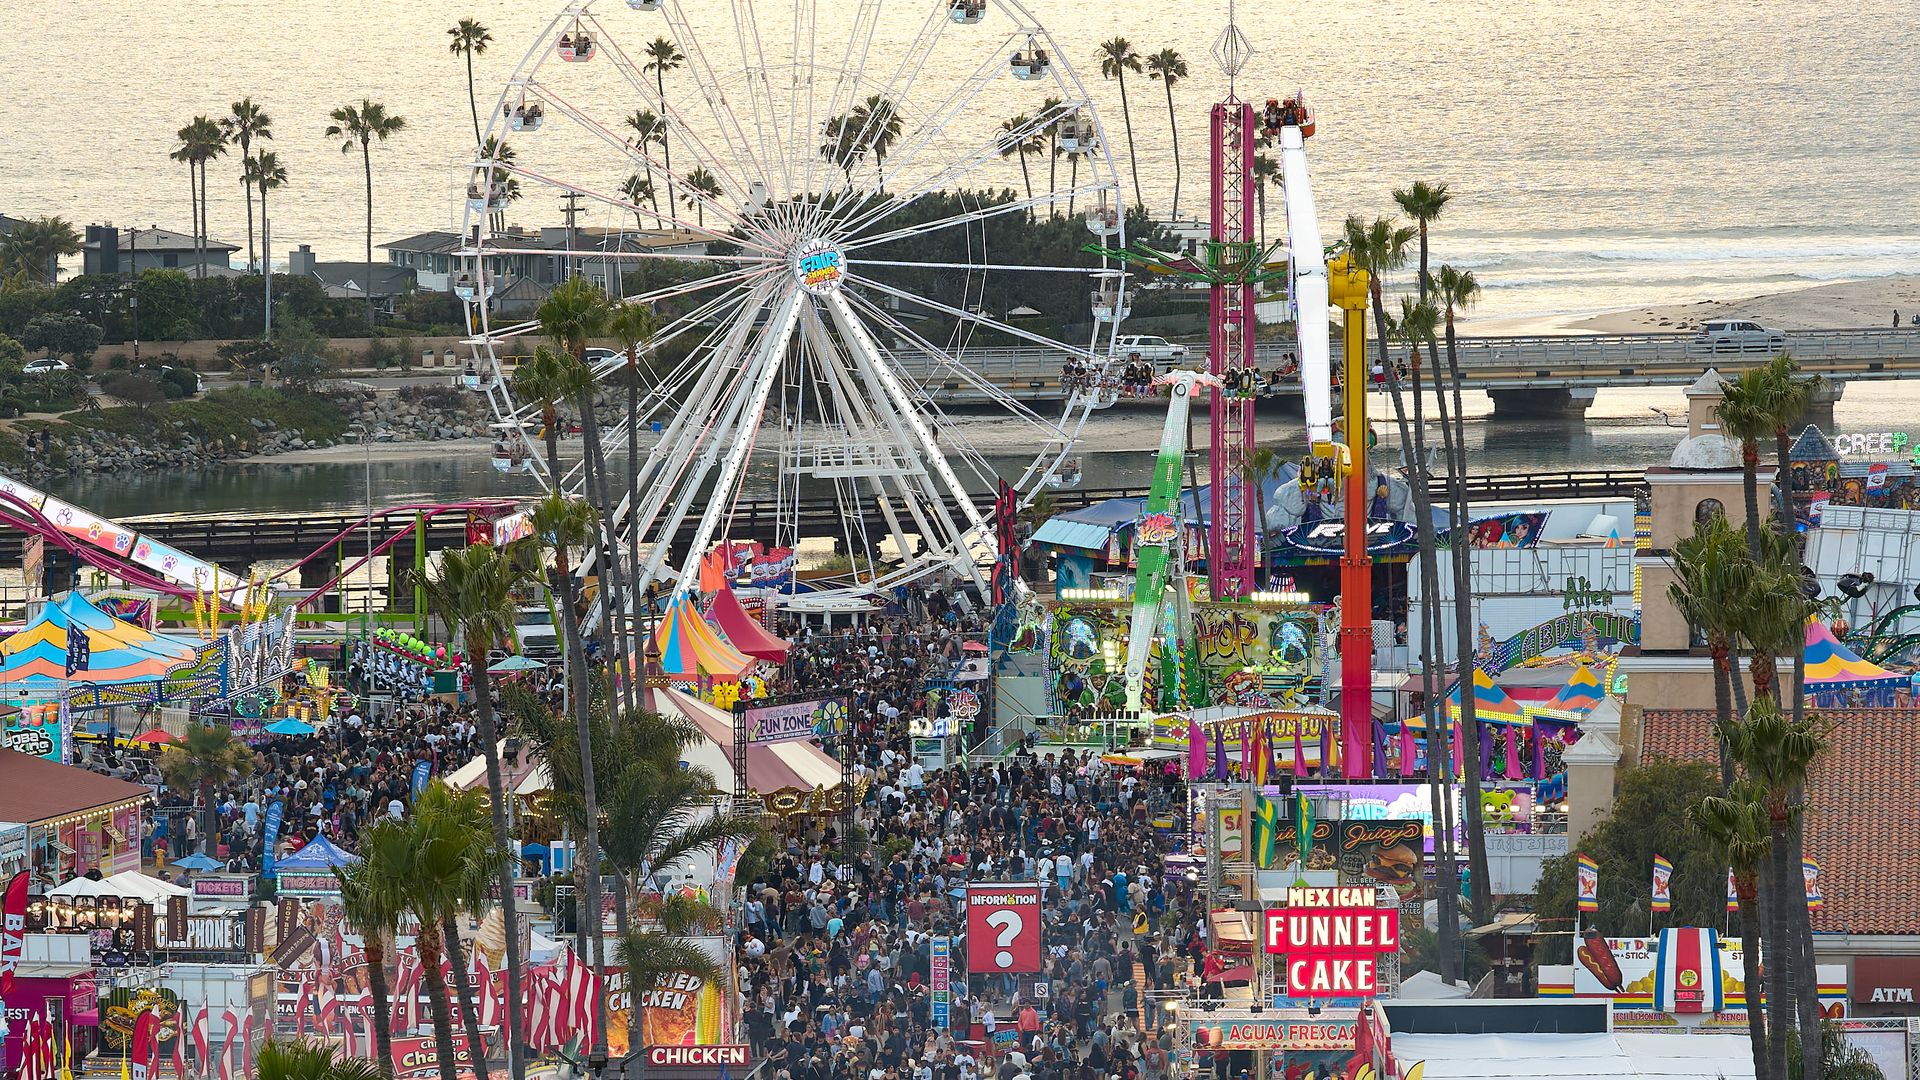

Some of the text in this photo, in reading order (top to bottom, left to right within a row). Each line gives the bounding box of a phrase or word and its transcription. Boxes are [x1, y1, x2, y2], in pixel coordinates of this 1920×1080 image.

[800, 251, 839, 274] FAIR
[1835, 432, 1908, 455] CREEP
[1307, 523, 1394, 538] RVE
[1563, 576, 1613, 609] Alien
[1191, 612, 1258, 666] HOP
[1522, 612, 1635, 663] ABDUCTIO
[951, 705, 977, 720] HOP
[760, 714, 811, 734] FUN ZONE
[196, 882, 243, 894] TICKETS
[282, 877, 341, 889] TICKETS
[1288, 888, 1375, 907] MEXICAN
[1268, 915, 1395, 946] FUNNEL
[2, 913, 25, 973] BAR
[1609, 939, 1631, 950] HOT
[1625, 952, 1650, 960] STICK
[1290, 960, 1374, 991] CAKE
[608, 990, 687, 1011] CHCKEN
[1870, 988, 1914, 1002] ATM
[1715, 1011, 1746, 1021] FRENCH
[1229, 1024, 1356, 1041] AGUAS FRESCAS
[651, 1048, 745, 1064] CHICKEN
